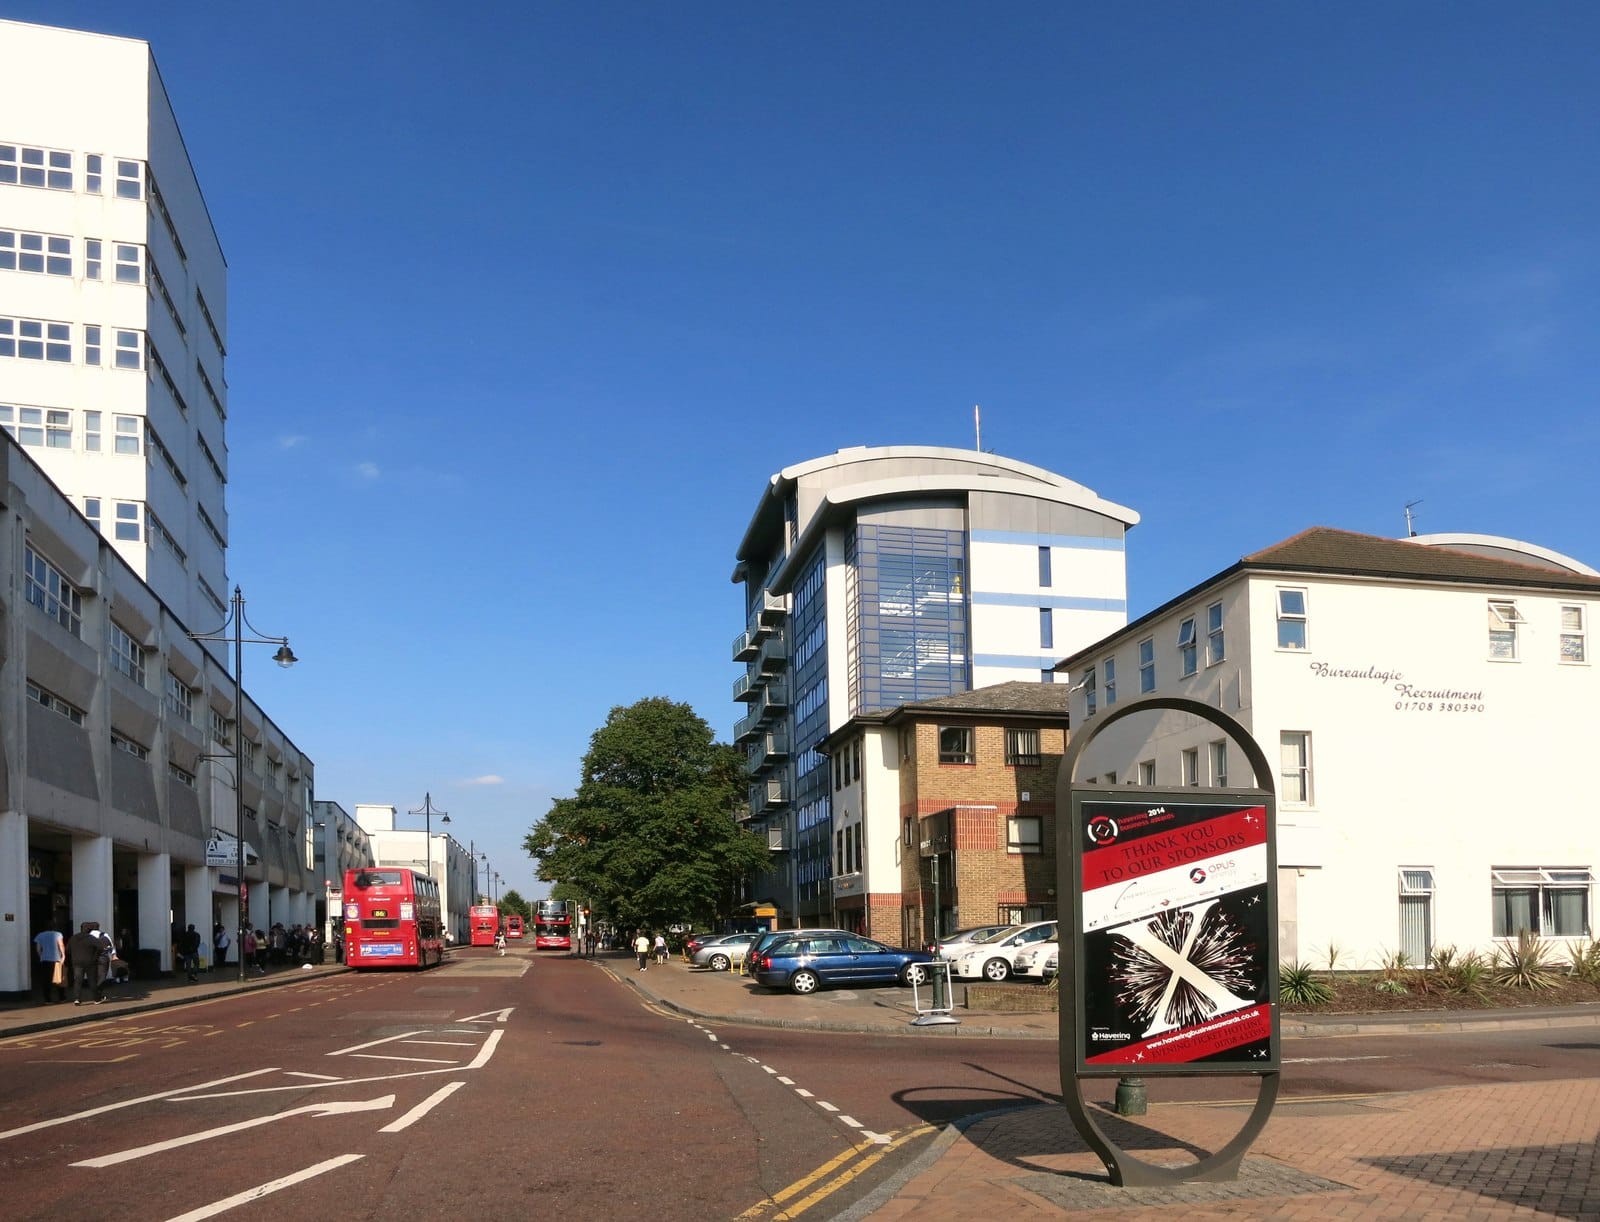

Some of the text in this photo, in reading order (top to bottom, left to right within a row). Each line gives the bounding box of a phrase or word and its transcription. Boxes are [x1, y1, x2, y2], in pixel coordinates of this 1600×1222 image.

[1309, 662, 1403, 684] Bureaulogic
[1394, 683, 1483, 700] Recruitment
[1394, 701, 1485, 713] 01708 380390
[1147, 807, 1166, 817] 2014
[1121, 825, 1215, 860] THANK YOU
[1100, 832, 1246, 881] TO OUR SPONSORS
[1208, 860, 1236, 874] OPUS
[1099, 1032, 1131, 1040] Havering
